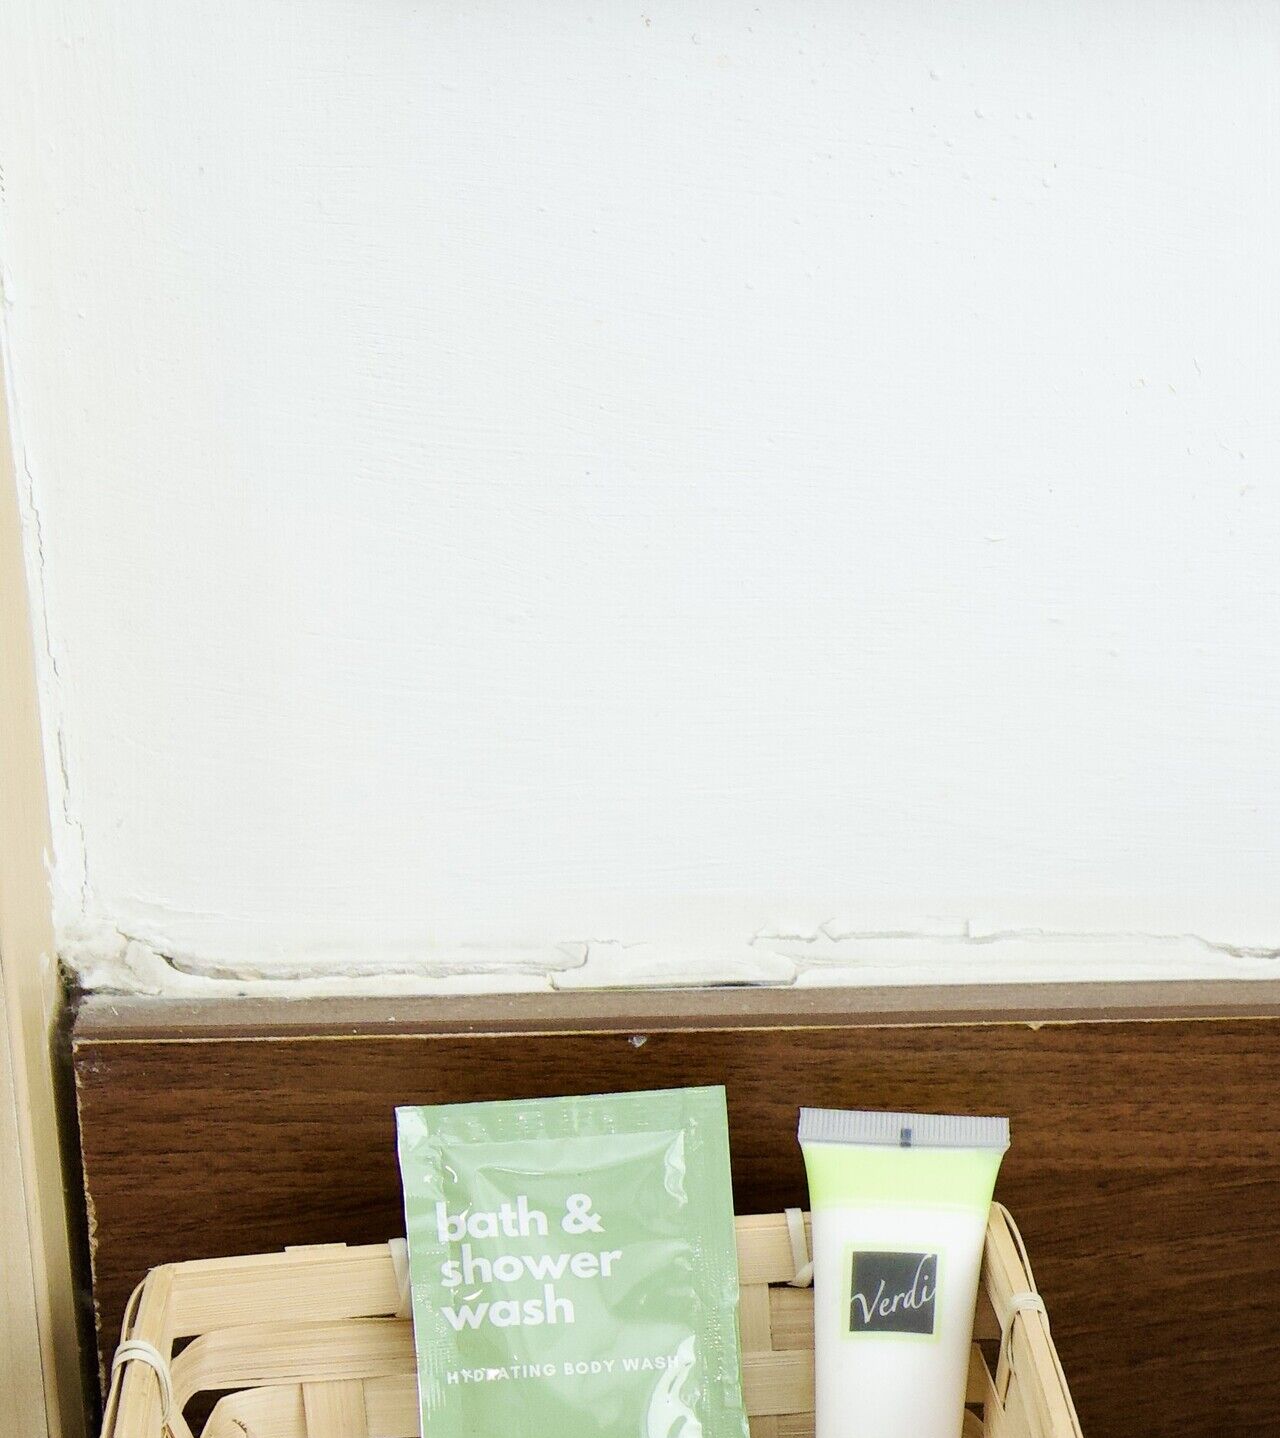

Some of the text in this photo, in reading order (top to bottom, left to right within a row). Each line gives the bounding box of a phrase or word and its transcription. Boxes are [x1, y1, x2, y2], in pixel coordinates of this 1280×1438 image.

[435, 1193, 606, 1244] bath &
[440, 1243, 624, 1288] shower
[851, 1253, 937, 1324] Verdi
[440, 1282, 576, 1332] wash
[446, 1355, 680, 1386] HYDRATING BODY WASH
